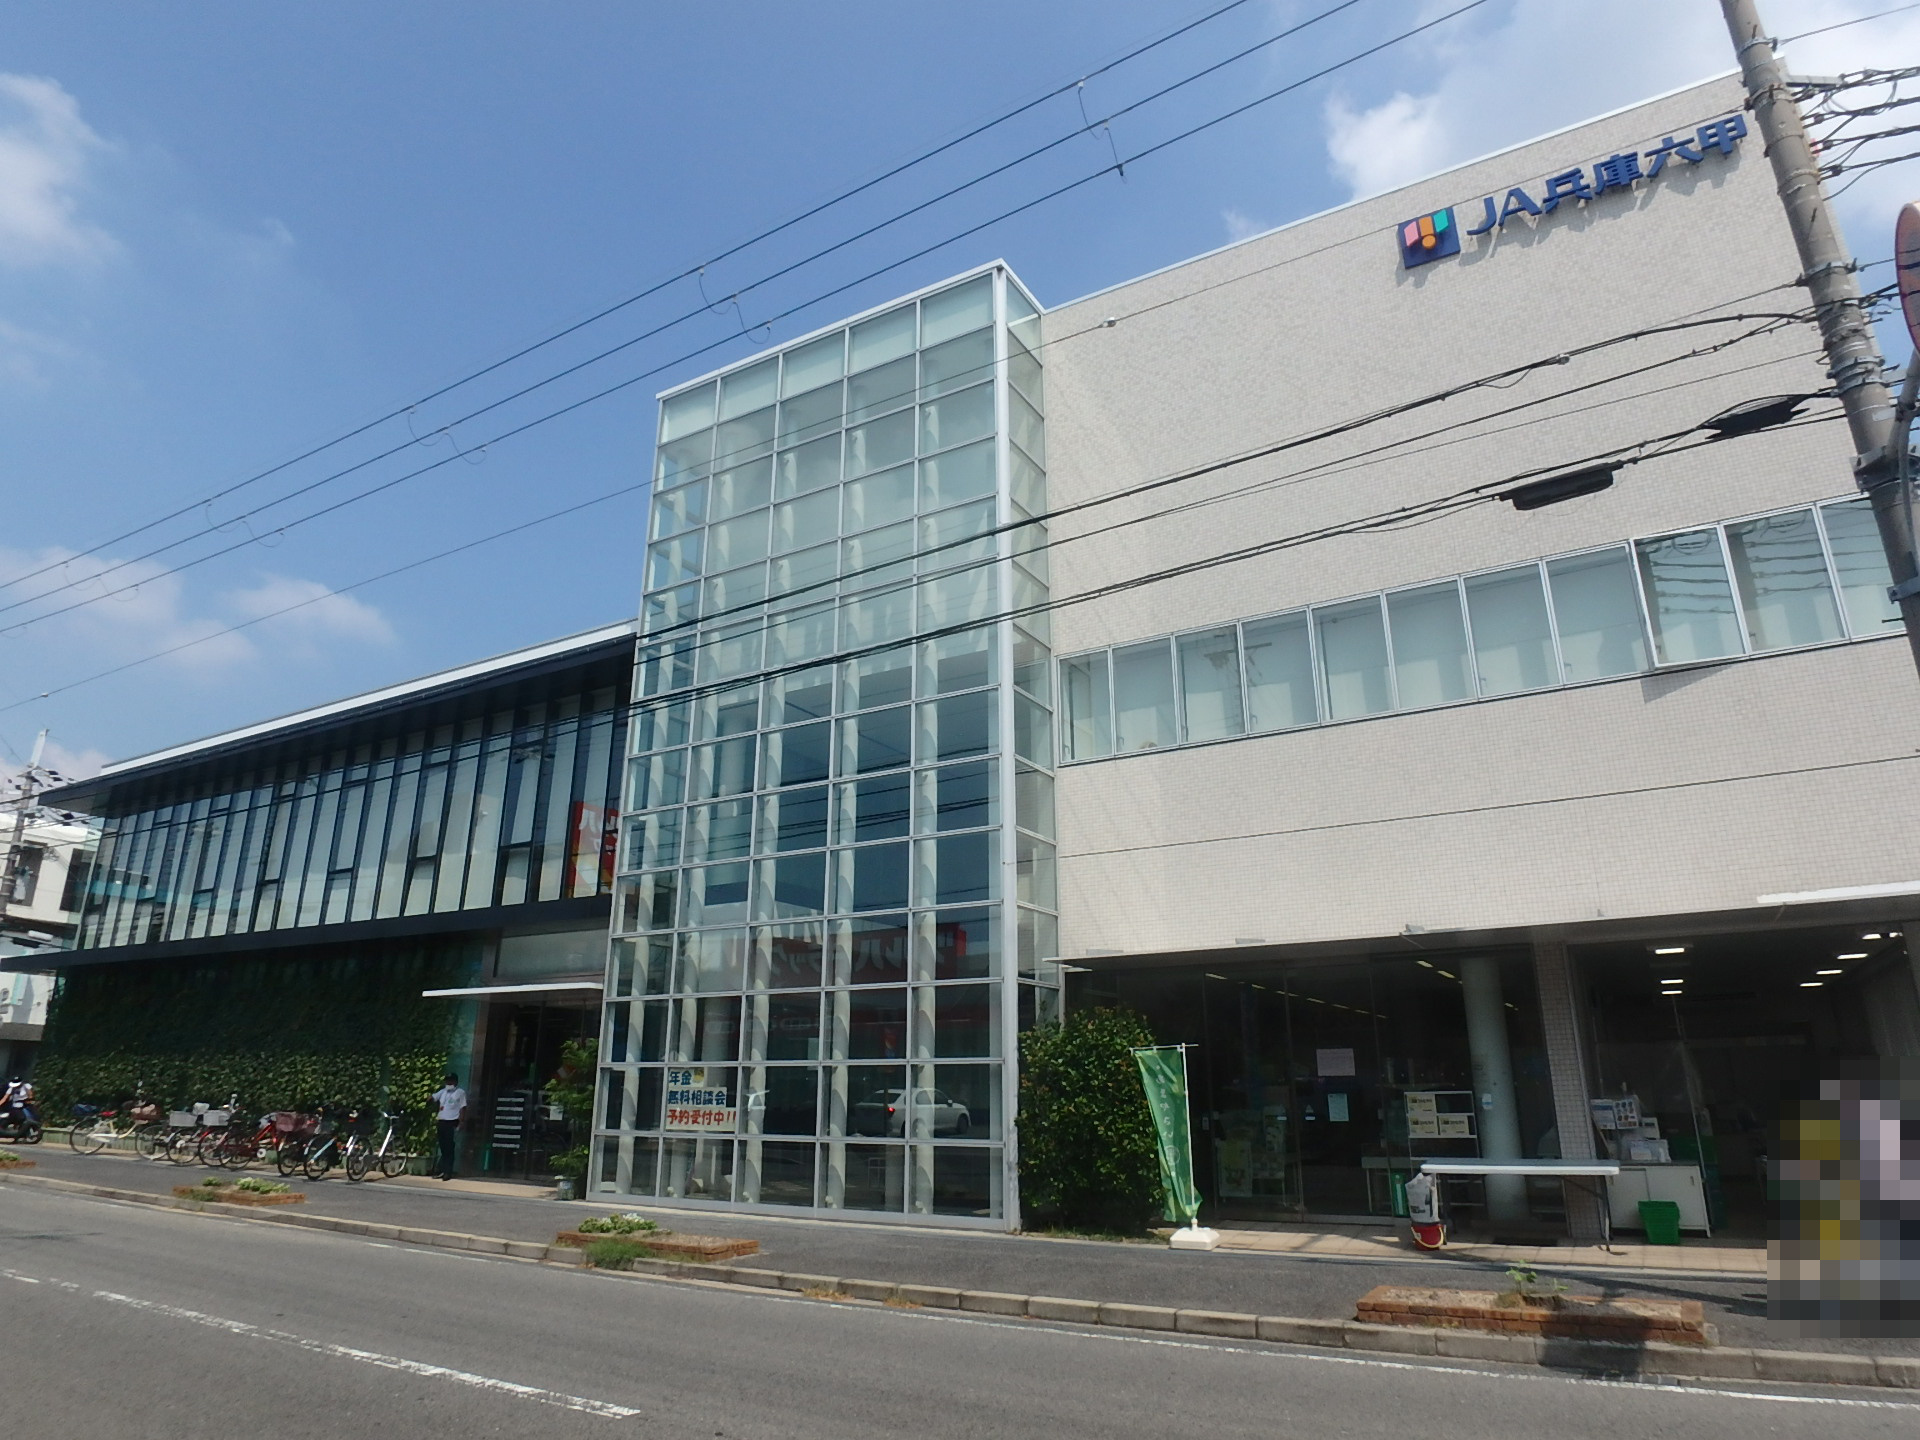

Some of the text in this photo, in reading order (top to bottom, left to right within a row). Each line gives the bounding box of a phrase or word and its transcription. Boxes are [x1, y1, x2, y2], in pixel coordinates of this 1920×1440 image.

[1466, 113, 1748, 236] JA兵庫六甲
[669, 1070, 693, 1086] 年金
[668, 1089, 726, 1106] 無料相談会
